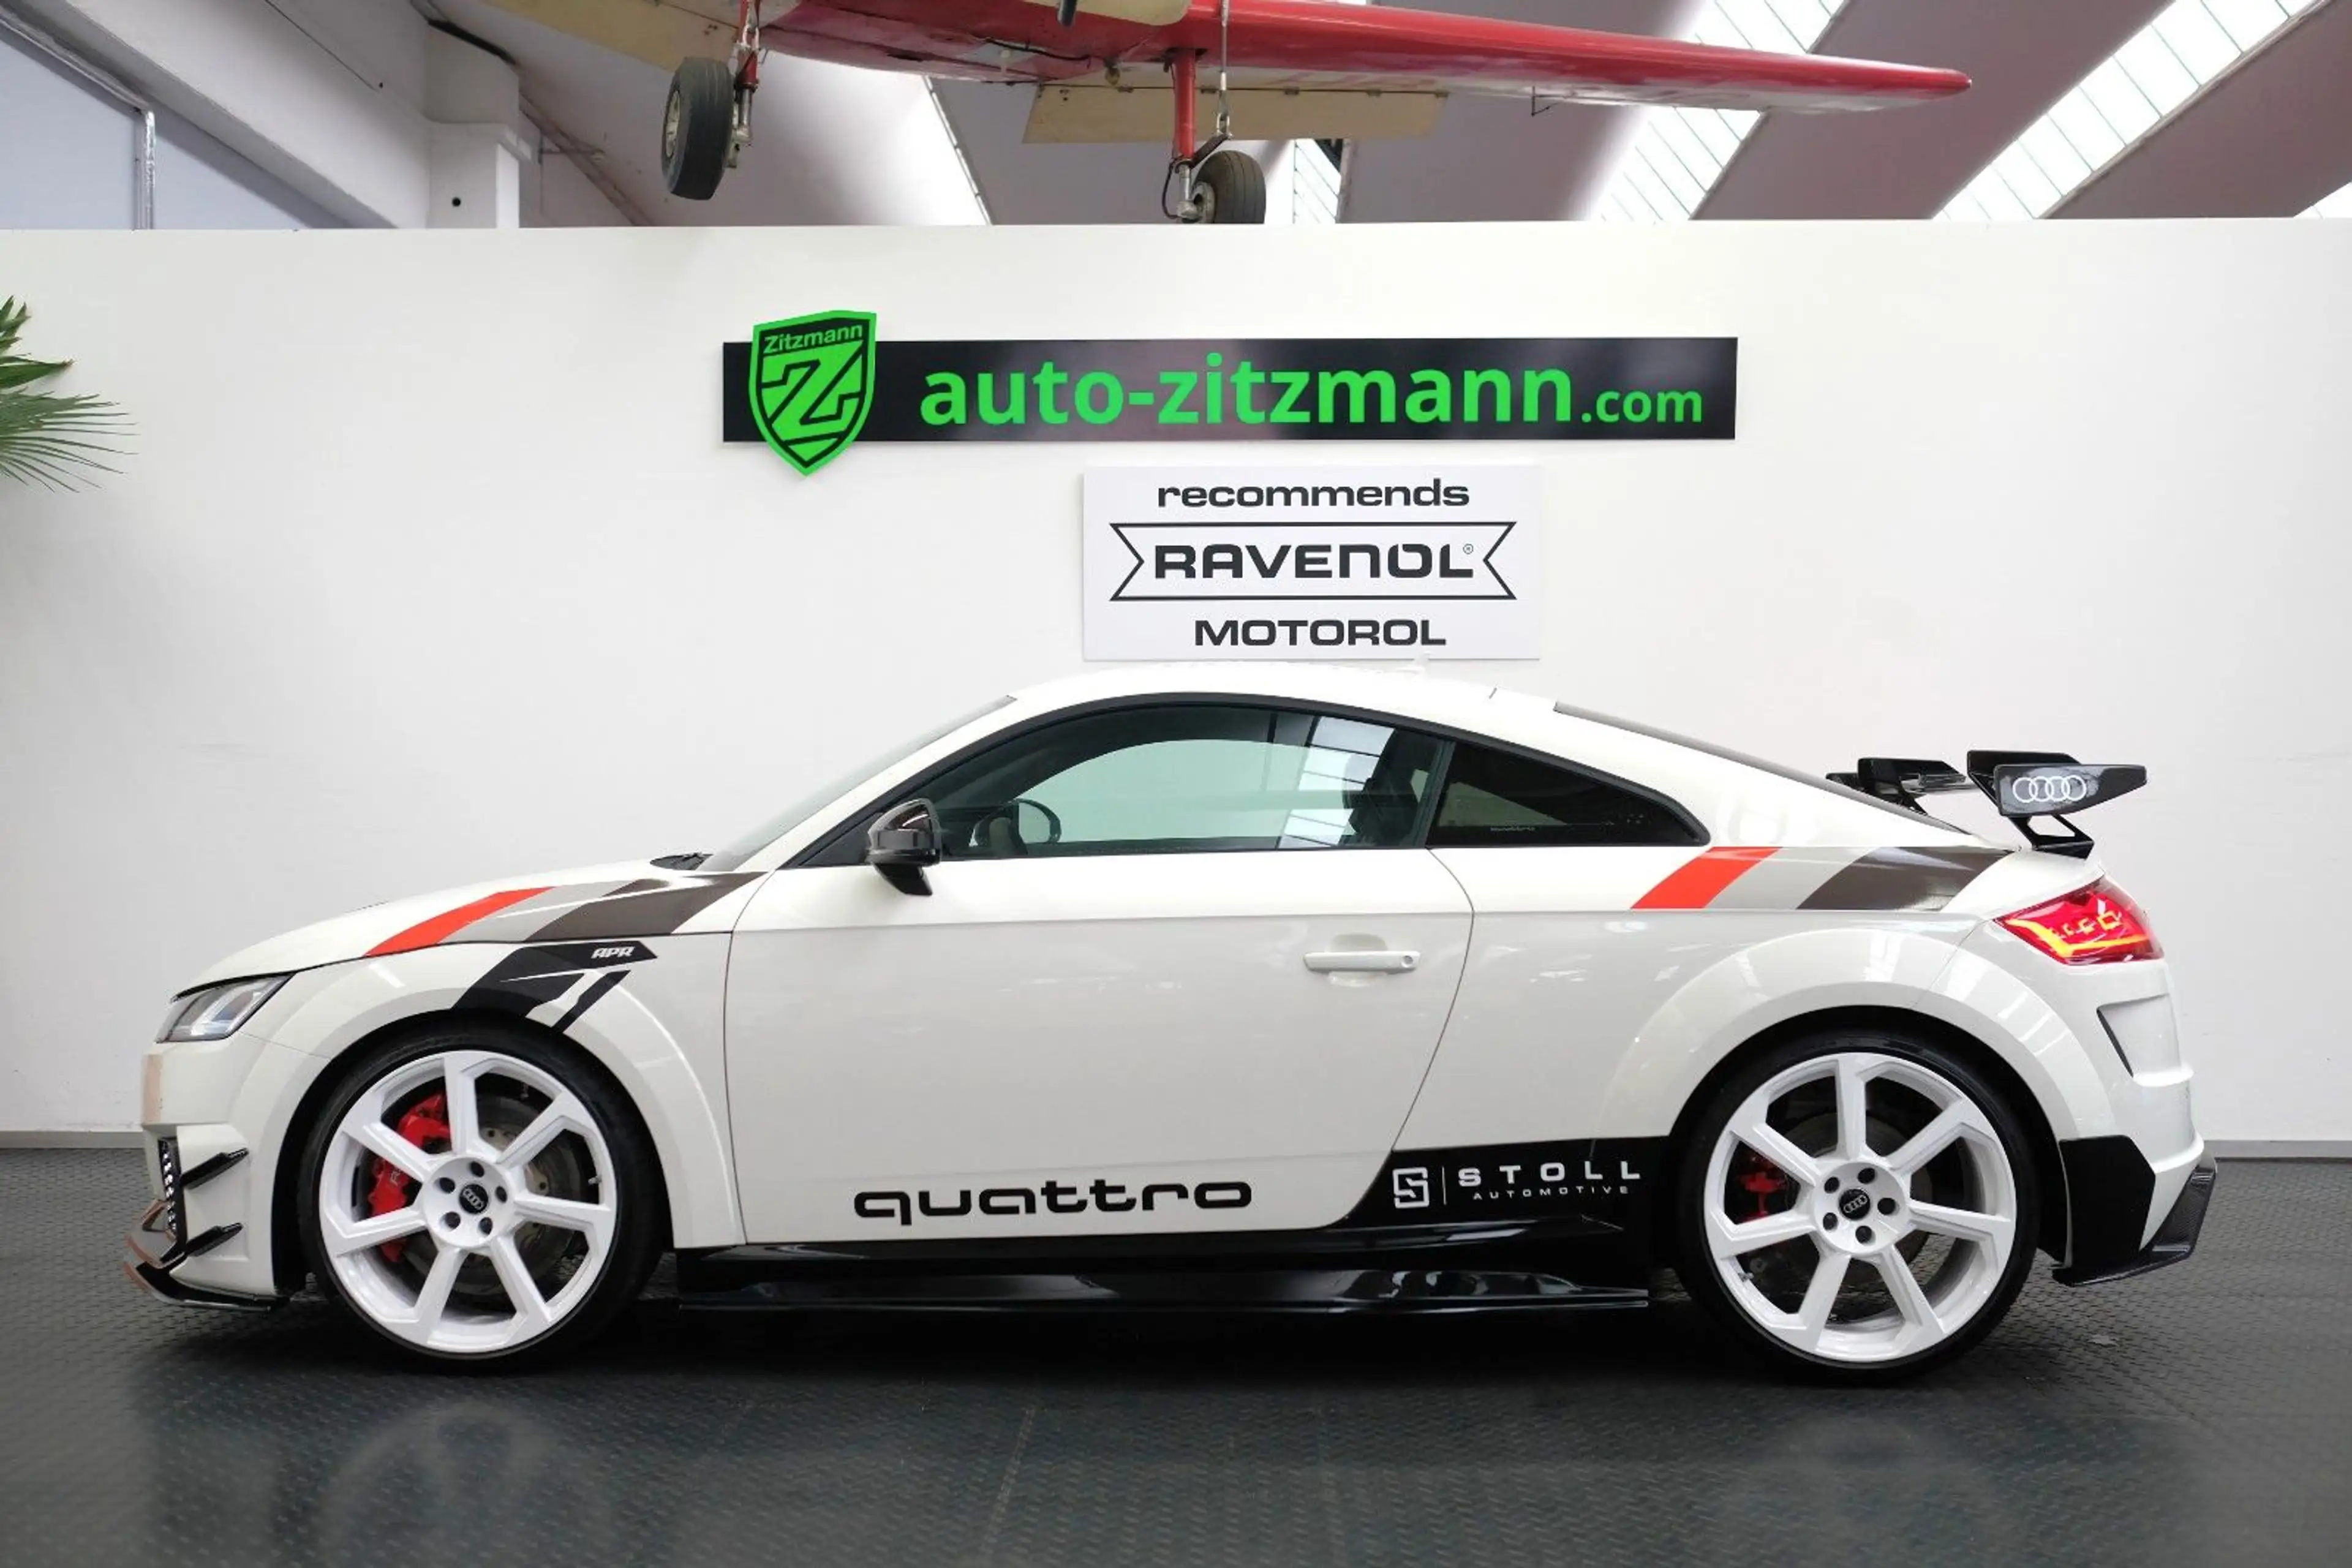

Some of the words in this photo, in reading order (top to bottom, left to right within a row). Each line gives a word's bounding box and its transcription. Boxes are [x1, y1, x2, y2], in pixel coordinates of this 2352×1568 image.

[763, 325, 864, 353] Zitzmann
[919, 352, 1704, 426] auto-zitzmann.com
[1158, 478, 1470, 508] recommends
[1195, 619, 1446, 646] MOTOROL
[590, 946, 635, 959] APR
[1458, 1161, 1641, 1188] STOLL
[854, 1179, 1252, 1226] quattro
[1472, 1186, 1629, 1200] AUTOMOTIVE
